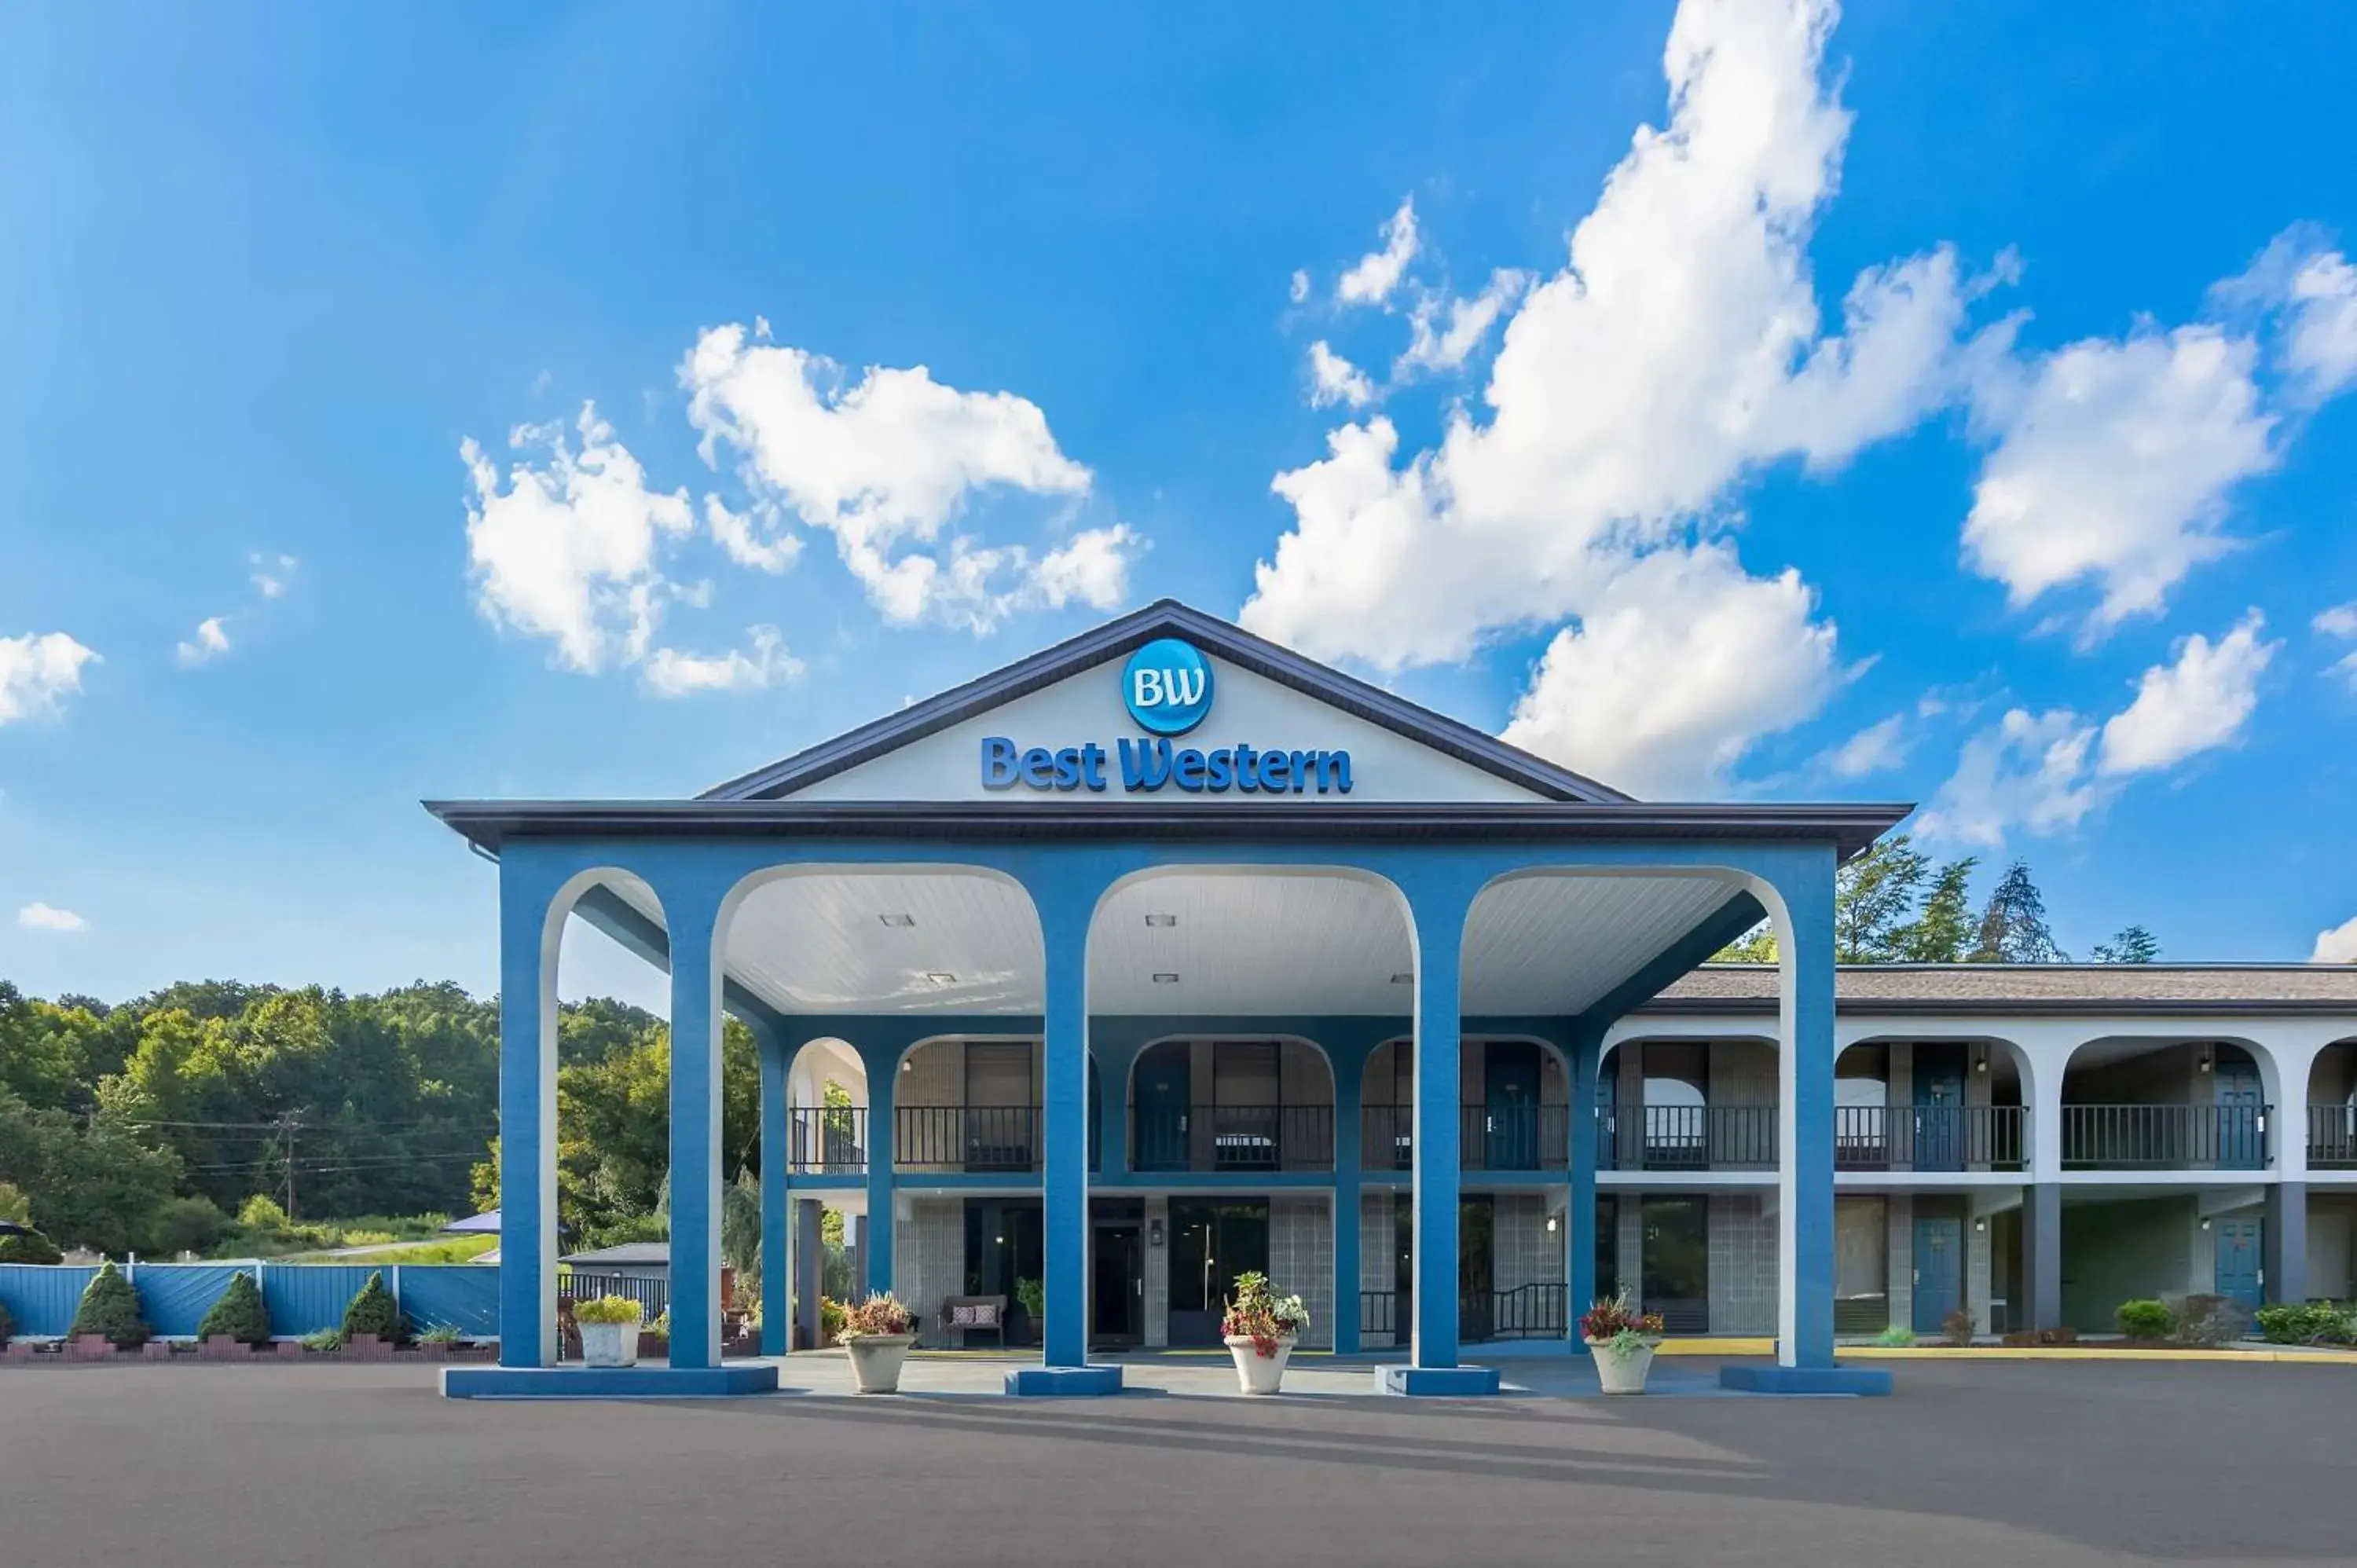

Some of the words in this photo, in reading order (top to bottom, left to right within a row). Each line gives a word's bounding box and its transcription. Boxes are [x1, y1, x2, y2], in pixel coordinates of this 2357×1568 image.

[1135, 669, 1204, 706] BW
[981, 737, 1107, 791] Best
[1116, 738, 1353, 793] Western
